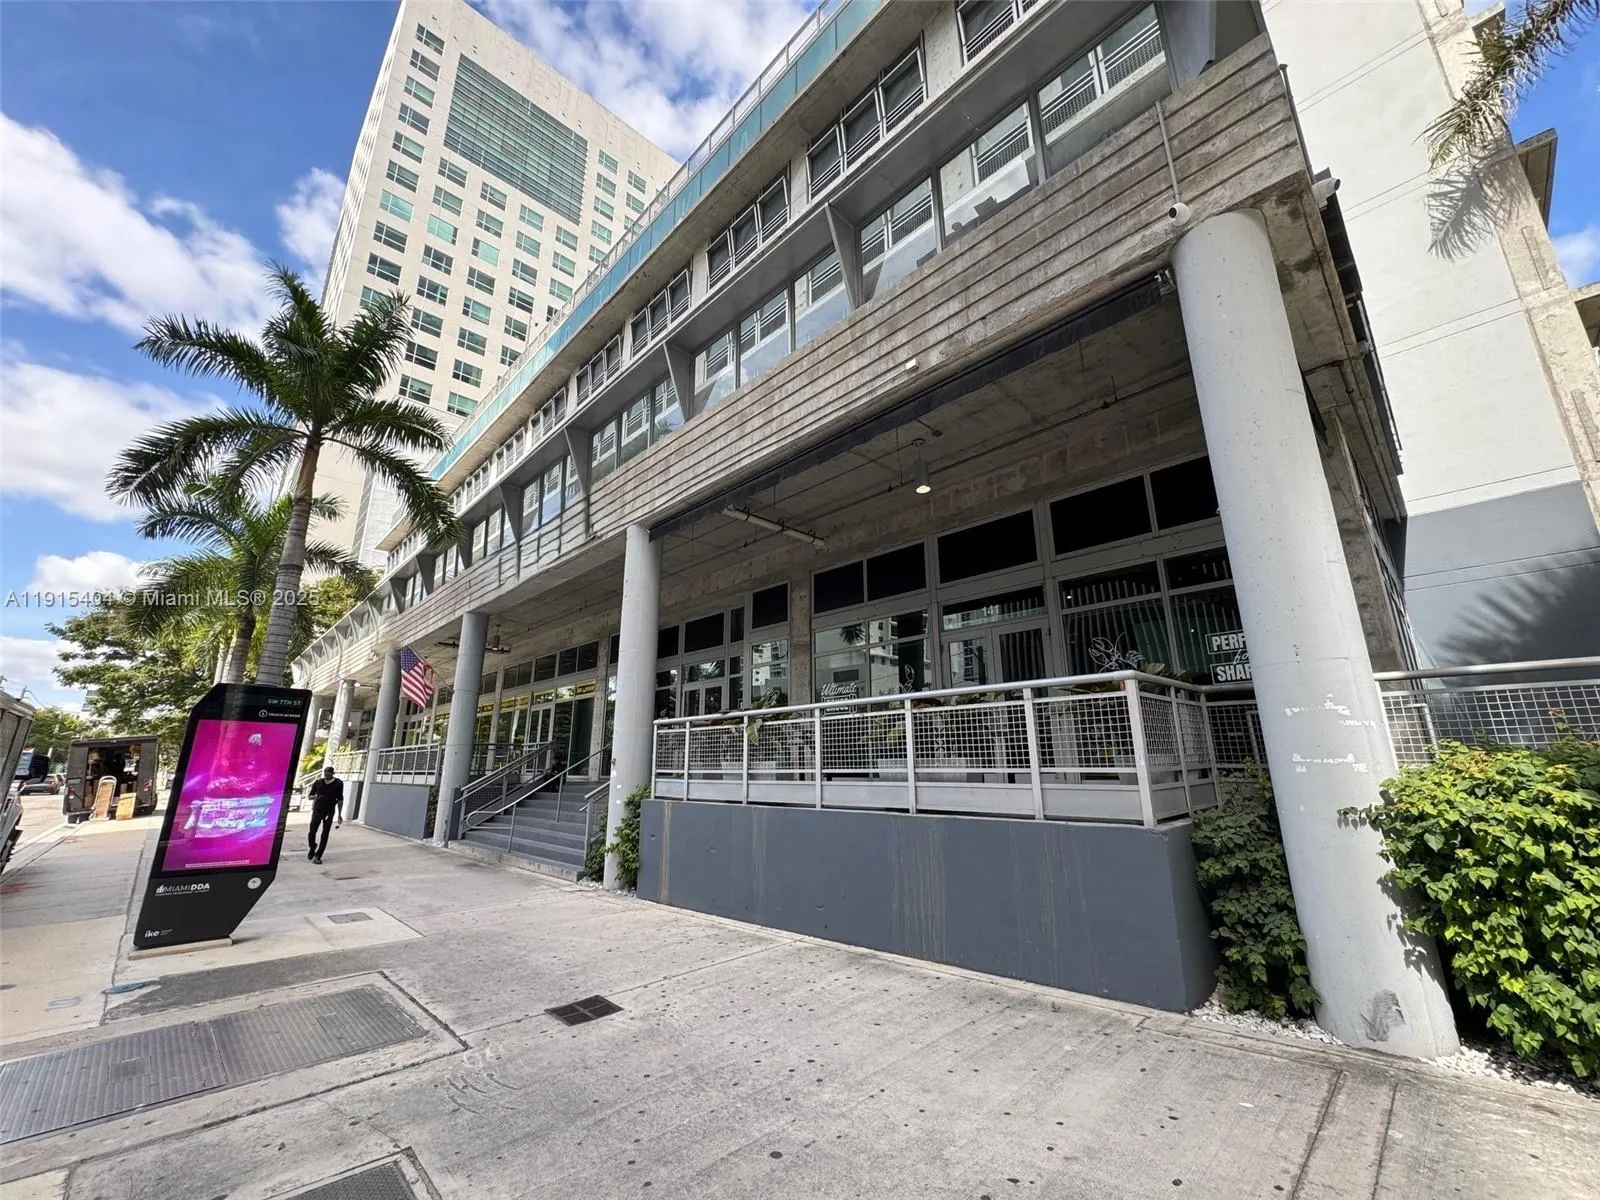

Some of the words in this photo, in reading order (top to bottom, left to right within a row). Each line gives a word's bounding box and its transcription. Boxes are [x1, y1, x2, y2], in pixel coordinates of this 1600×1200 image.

[982, 604, 999, 616] 141
[821, 682, 857, 696] Ultimate
[144, 929, 160, 938] ike
